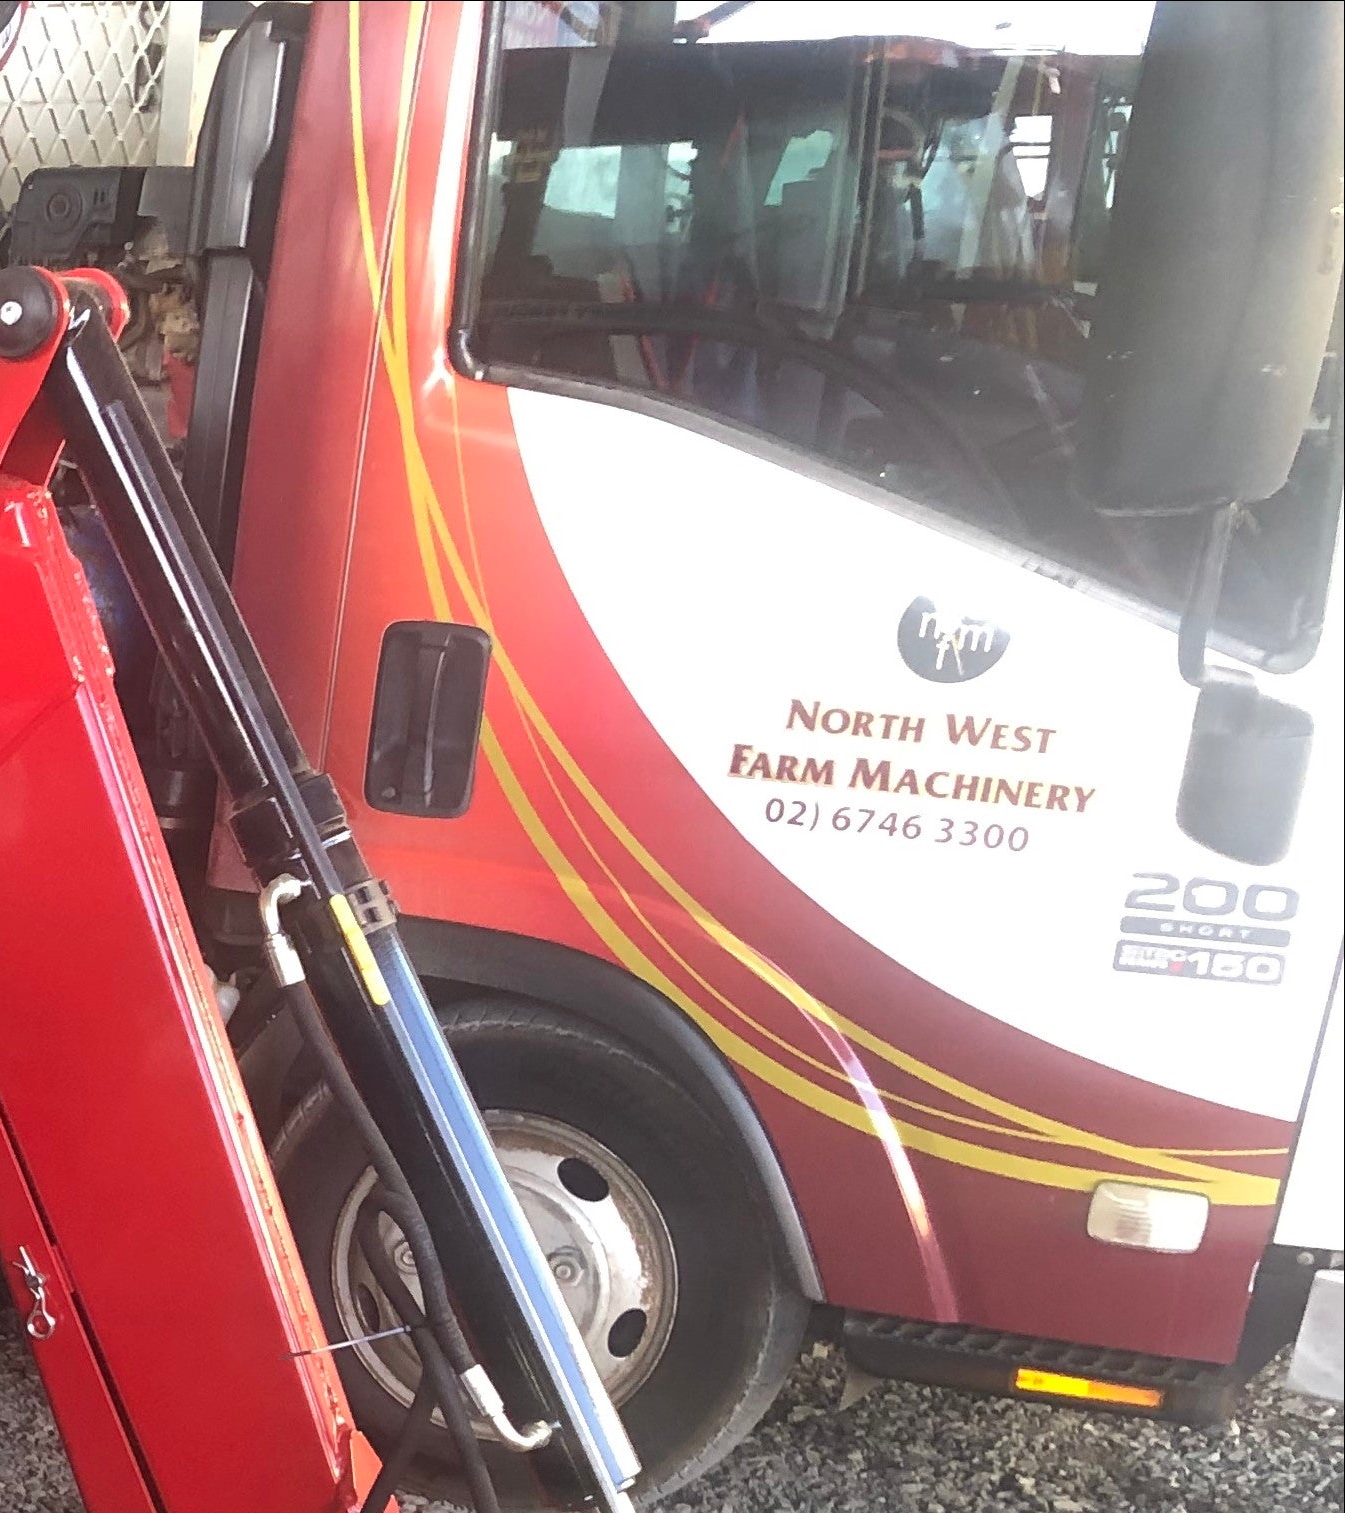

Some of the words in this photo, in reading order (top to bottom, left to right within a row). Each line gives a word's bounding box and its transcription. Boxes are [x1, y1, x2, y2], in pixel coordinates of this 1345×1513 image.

[785, 699, 926, 744] NORTH
[947, 714, 1058, 755] WEST
[728, 744, 835, 787] FARM
[848, 757, 1096, 813] MACHINERY
[830, 805, 923, 841] 6746
[934, 818, 1030, 852] 3300
[1124, 872, 1300, 921] 200
[1161, 922, 1251, 940] SHORT
